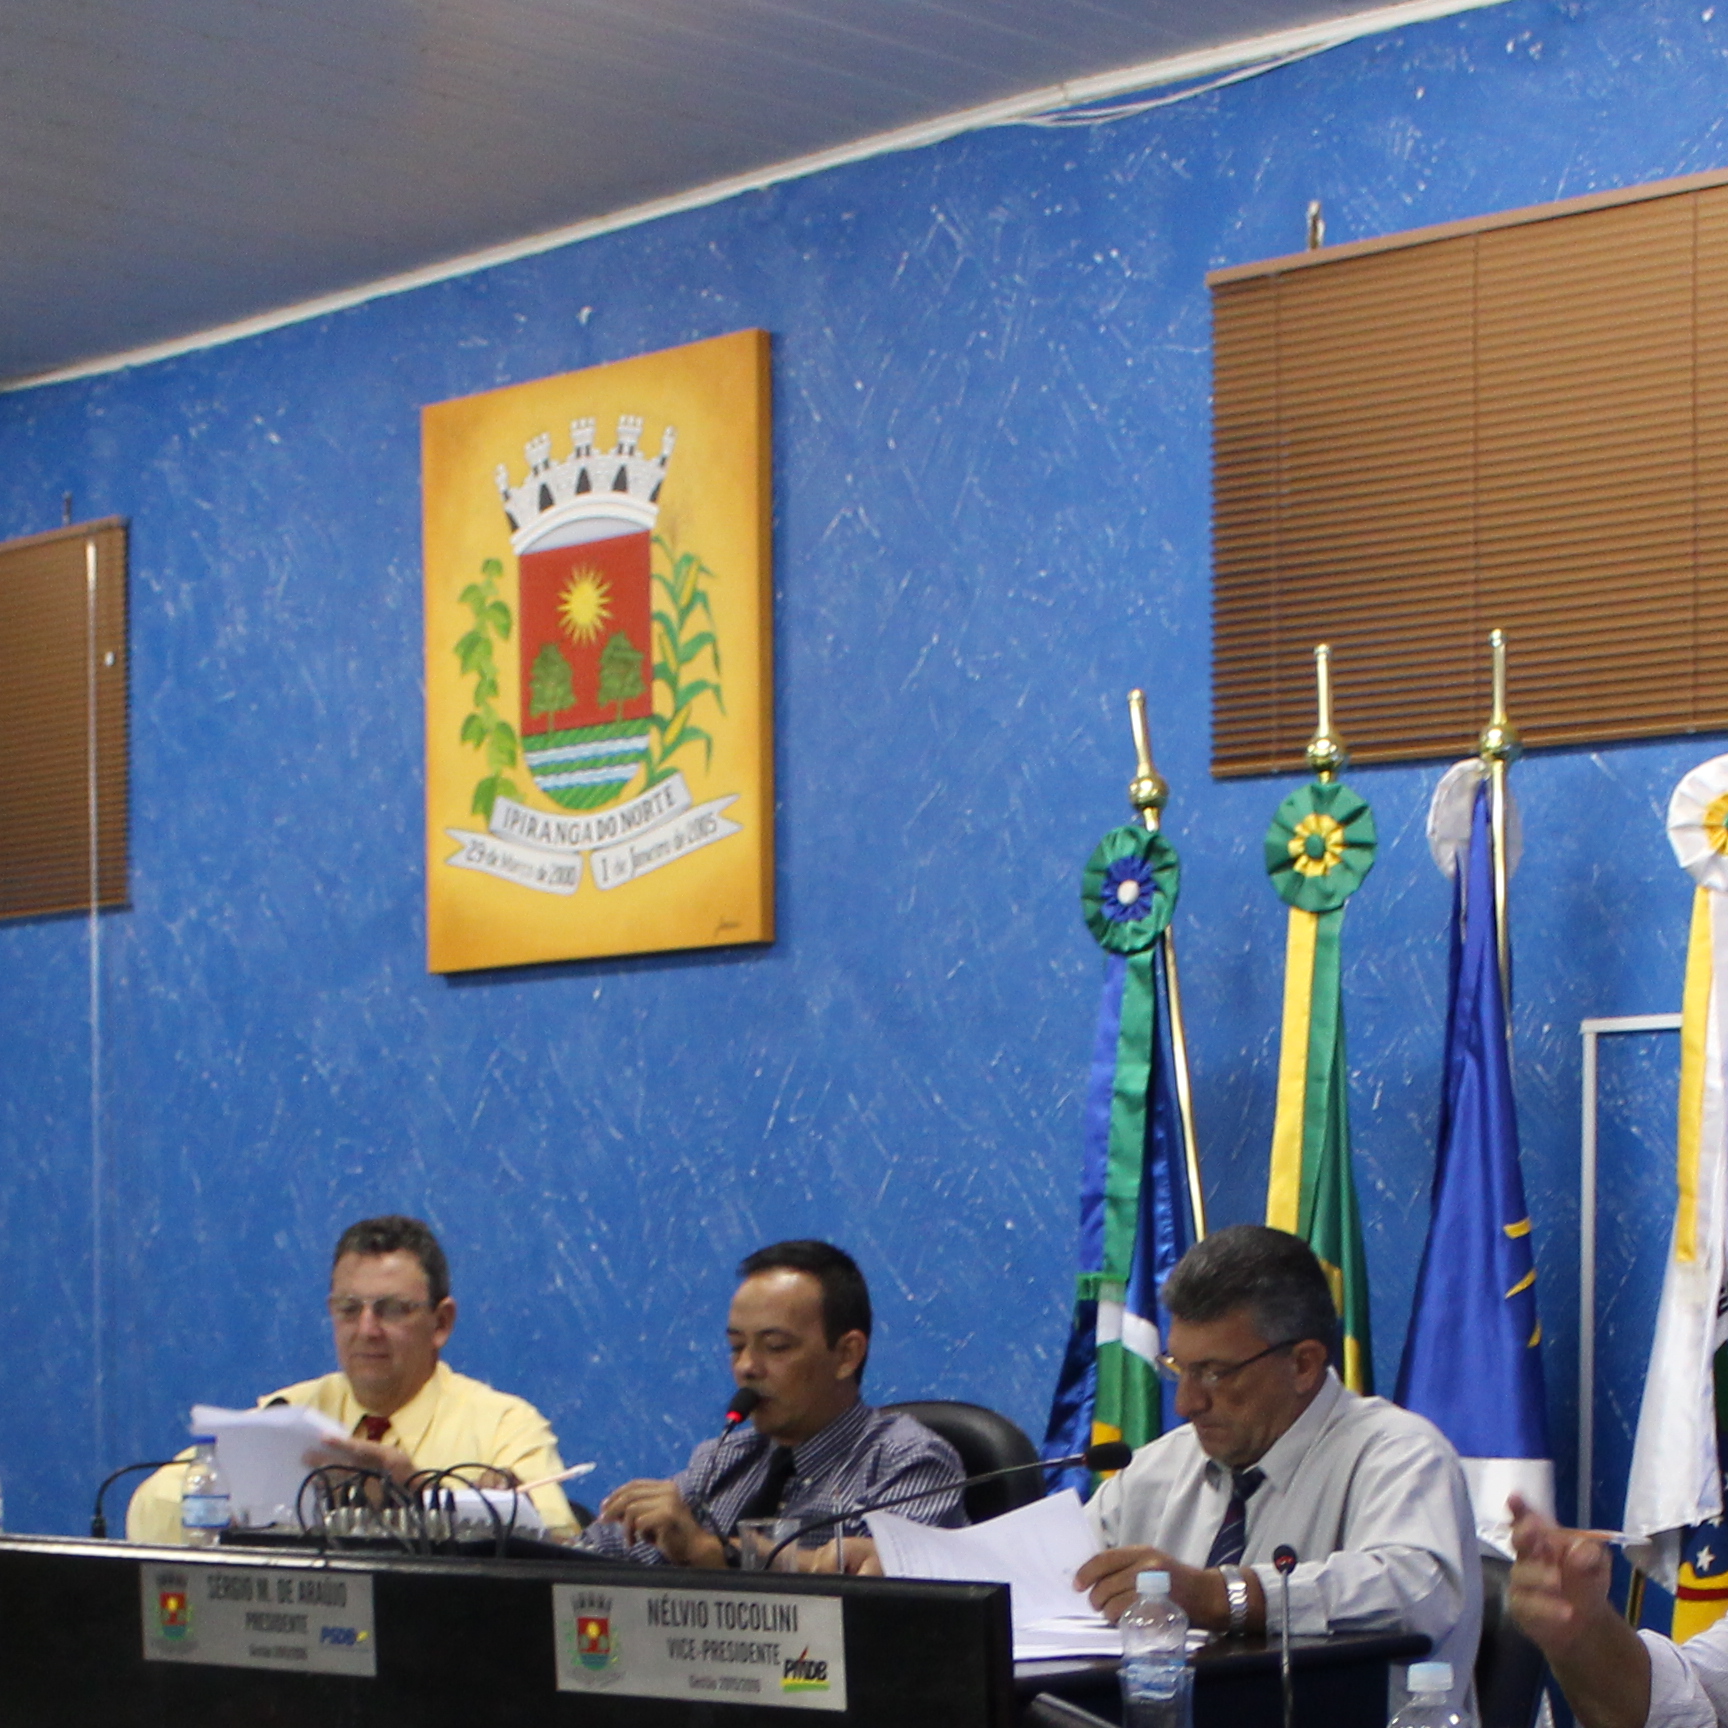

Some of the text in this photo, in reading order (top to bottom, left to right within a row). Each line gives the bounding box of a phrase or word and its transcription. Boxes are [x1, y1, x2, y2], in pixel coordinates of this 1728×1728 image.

[503, 784, 676, 845] IPIRANGA DO NORTE
[207, 1573, 253, 1602] SÉRGIO
[277, 1578, 294, 1604] DE
[298, 1577, 348, 1608] ARAÚJO
[245, 1612, 308, 1634] PRESIDENTE
[647, 1593, 799, 1634] NÉLVIO TOCOLINI
[320, 1625, 356, 1646] PSDB
[667, 1637, 781, 1666] VICE-PRESIDENTE
